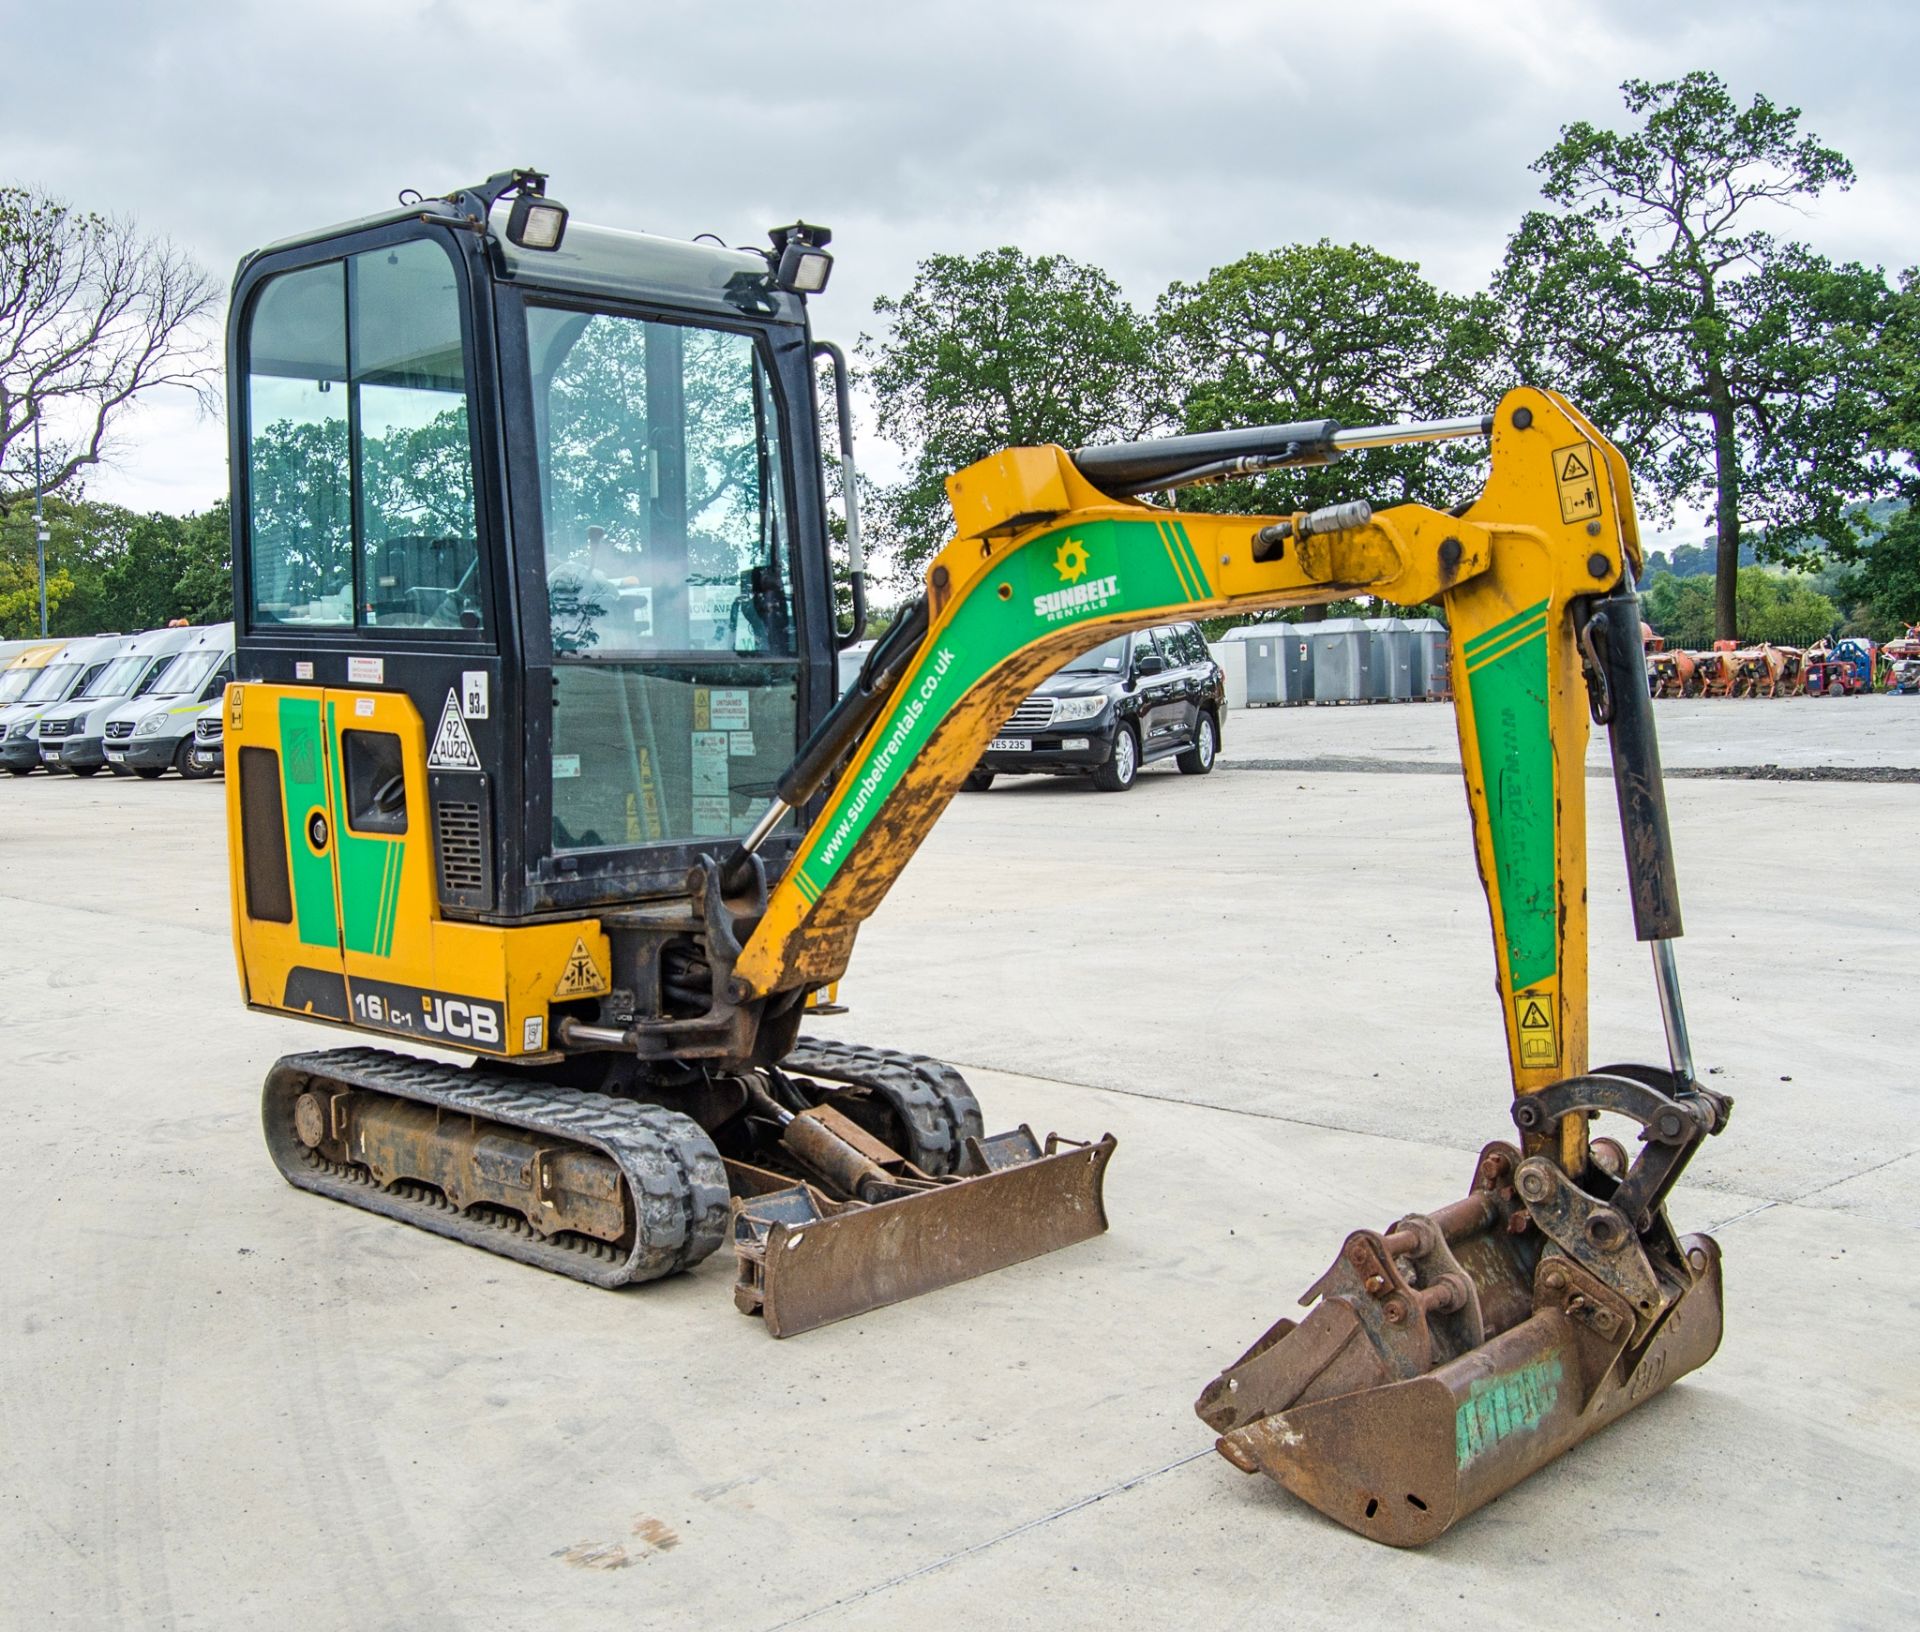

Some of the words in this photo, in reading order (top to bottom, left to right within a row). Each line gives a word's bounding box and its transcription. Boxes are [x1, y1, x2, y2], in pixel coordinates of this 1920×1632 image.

[1033, 575, 1118, 617] SUNBELT
[1046, 598, 1108, 622] RENTALS
[468, 692, 480, 714] 93
[446, 720, 460, 739] 92
[440, 741, 468, 759] AU2Q
[820, 647, 956, 866] www.sunbeltrentals.co.uk
[355, 993, 383, 1021] 16
[422, 996, 499, 1043] JCB
